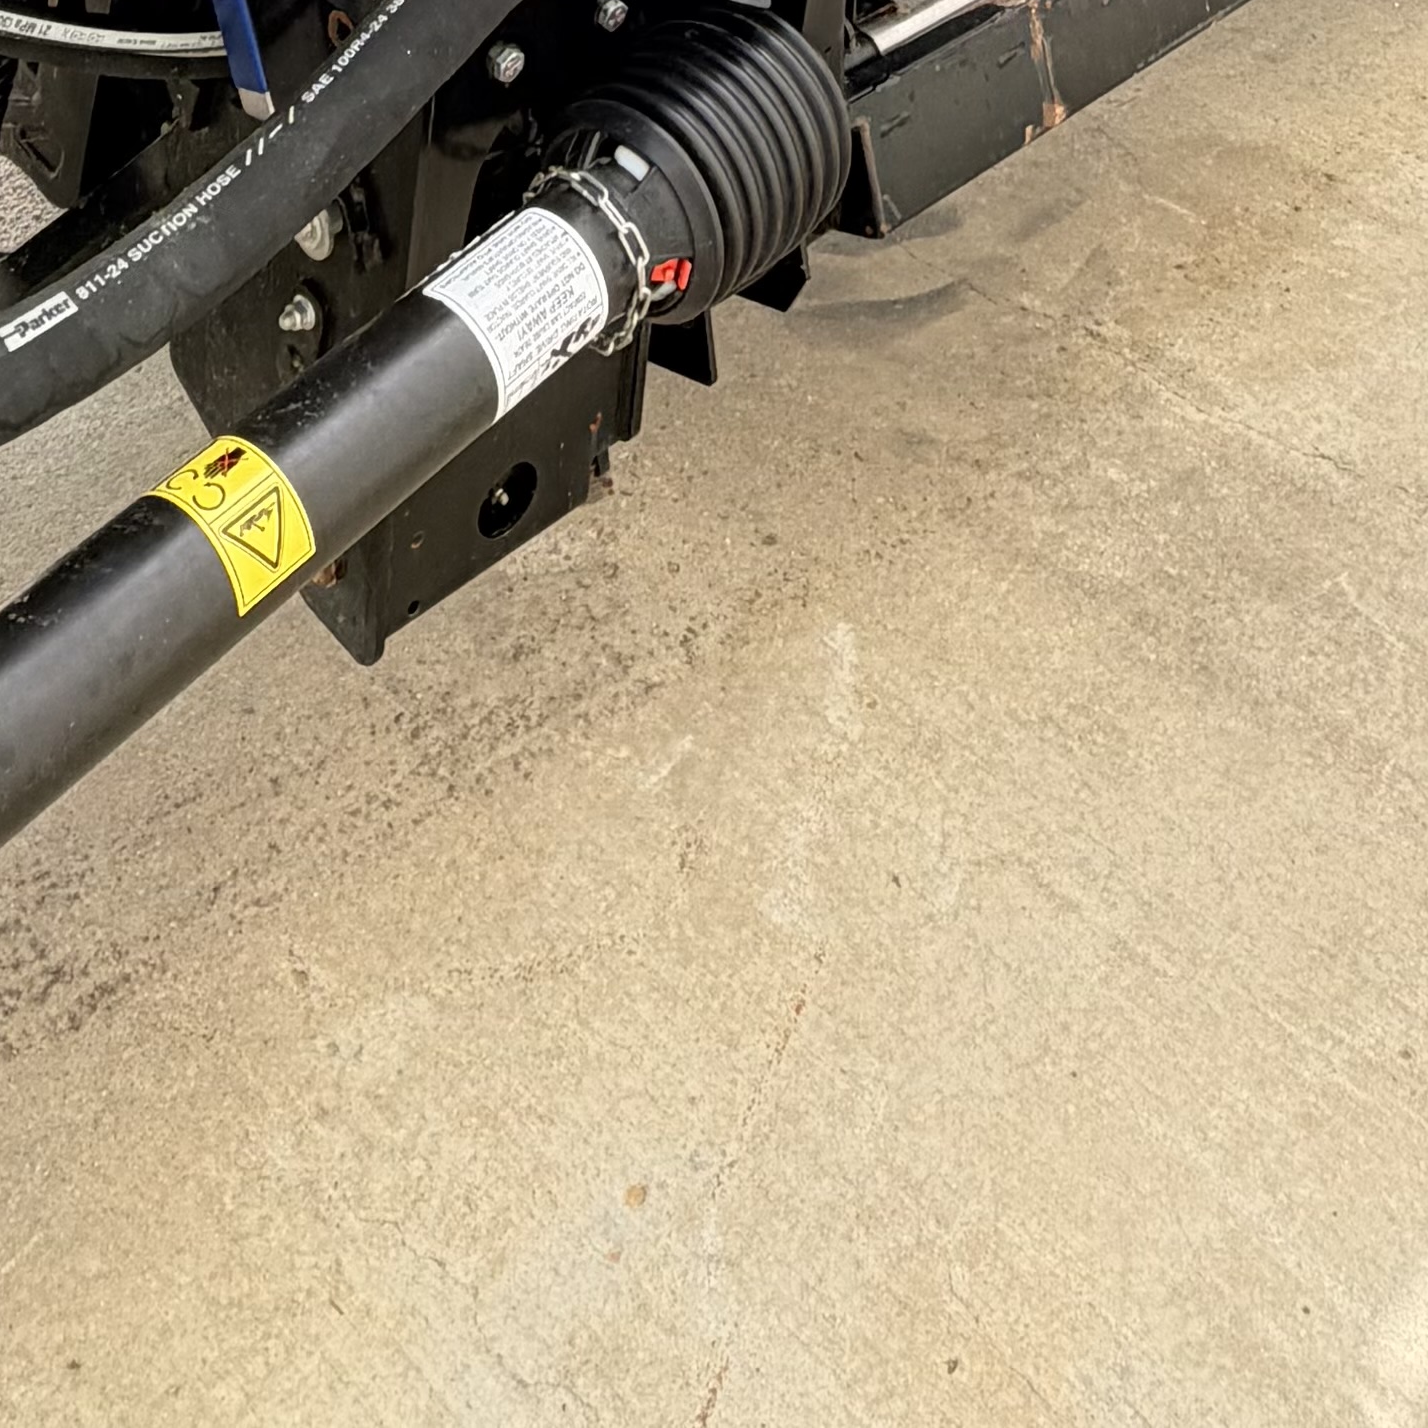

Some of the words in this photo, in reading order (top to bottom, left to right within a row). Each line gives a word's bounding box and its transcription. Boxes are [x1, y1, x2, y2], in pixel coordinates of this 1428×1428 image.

[301, 73, 334, 103] SAE
[332, 14, 389, 74] 100R4-24
[75, 257, 129, 300] 811-24
[127, 203, 198, 262] SUCTION
[195, 164, 242, 206] HOSE
[514, 308, 550, 342] AWAY!
[546, 285, 577, 315] KEEP
